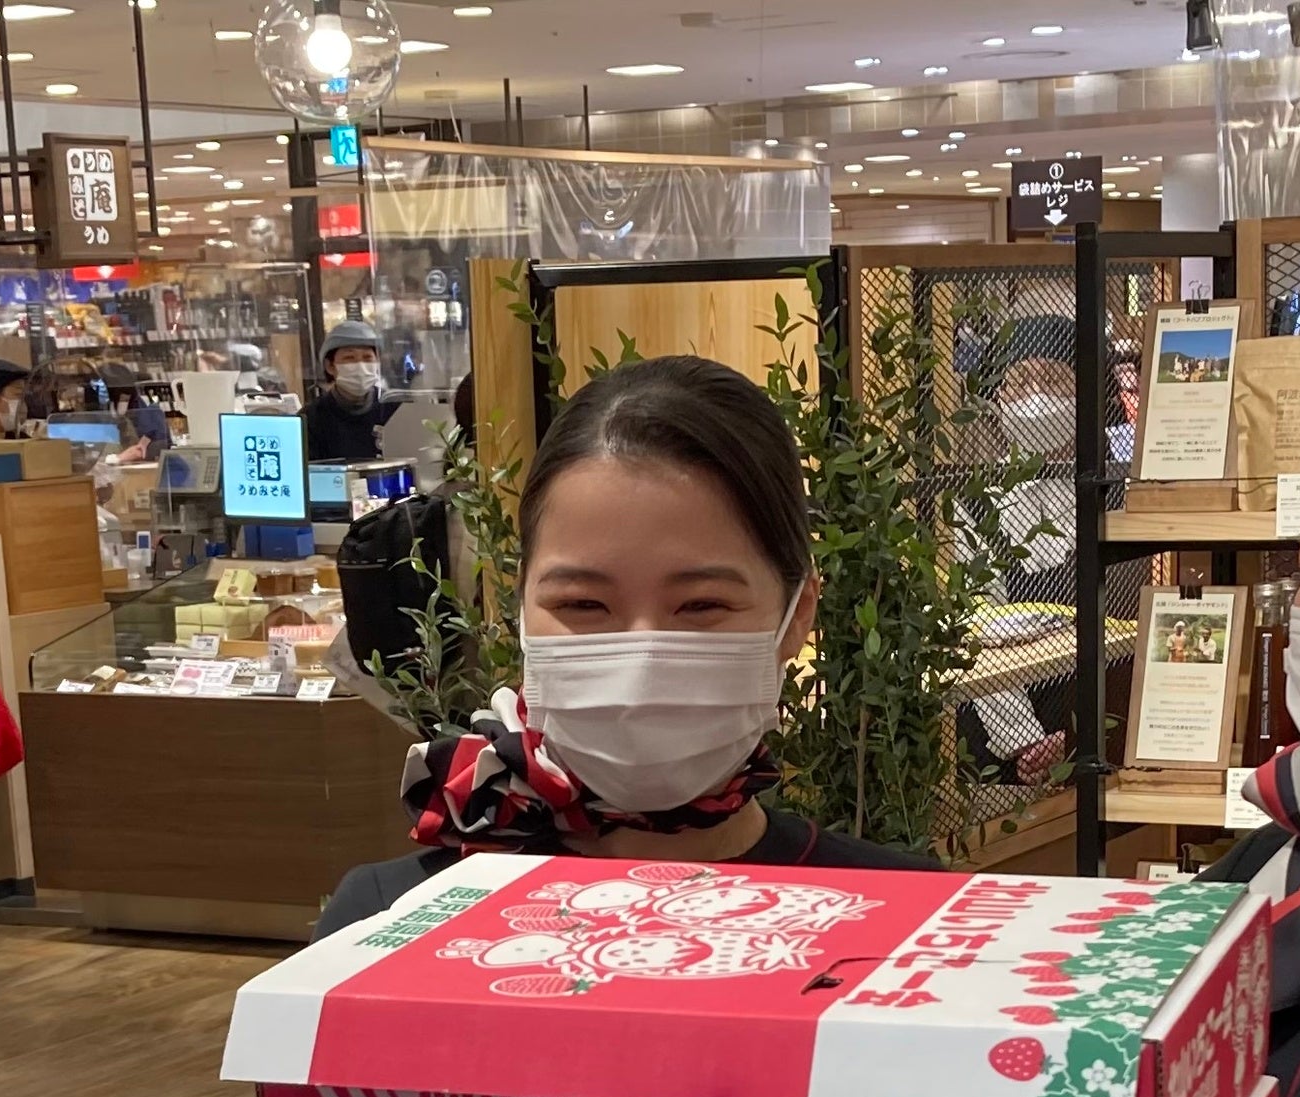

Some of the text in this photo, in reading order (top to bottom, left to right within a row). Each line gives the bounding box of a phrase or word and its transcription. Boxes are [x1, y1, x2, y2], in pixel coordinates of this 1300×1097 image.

[1019, 178, 1095, 196] 袋詰めサービス
[1046, 194, 1069, 208] レジ
[84, 225, 110, 244] うめ
[238, 484, 291, 497] うめみそ庵
[353, 886, 493, 948] 鹿児島県産
[844, 880, 1042, 1008] 北山いちご一会
